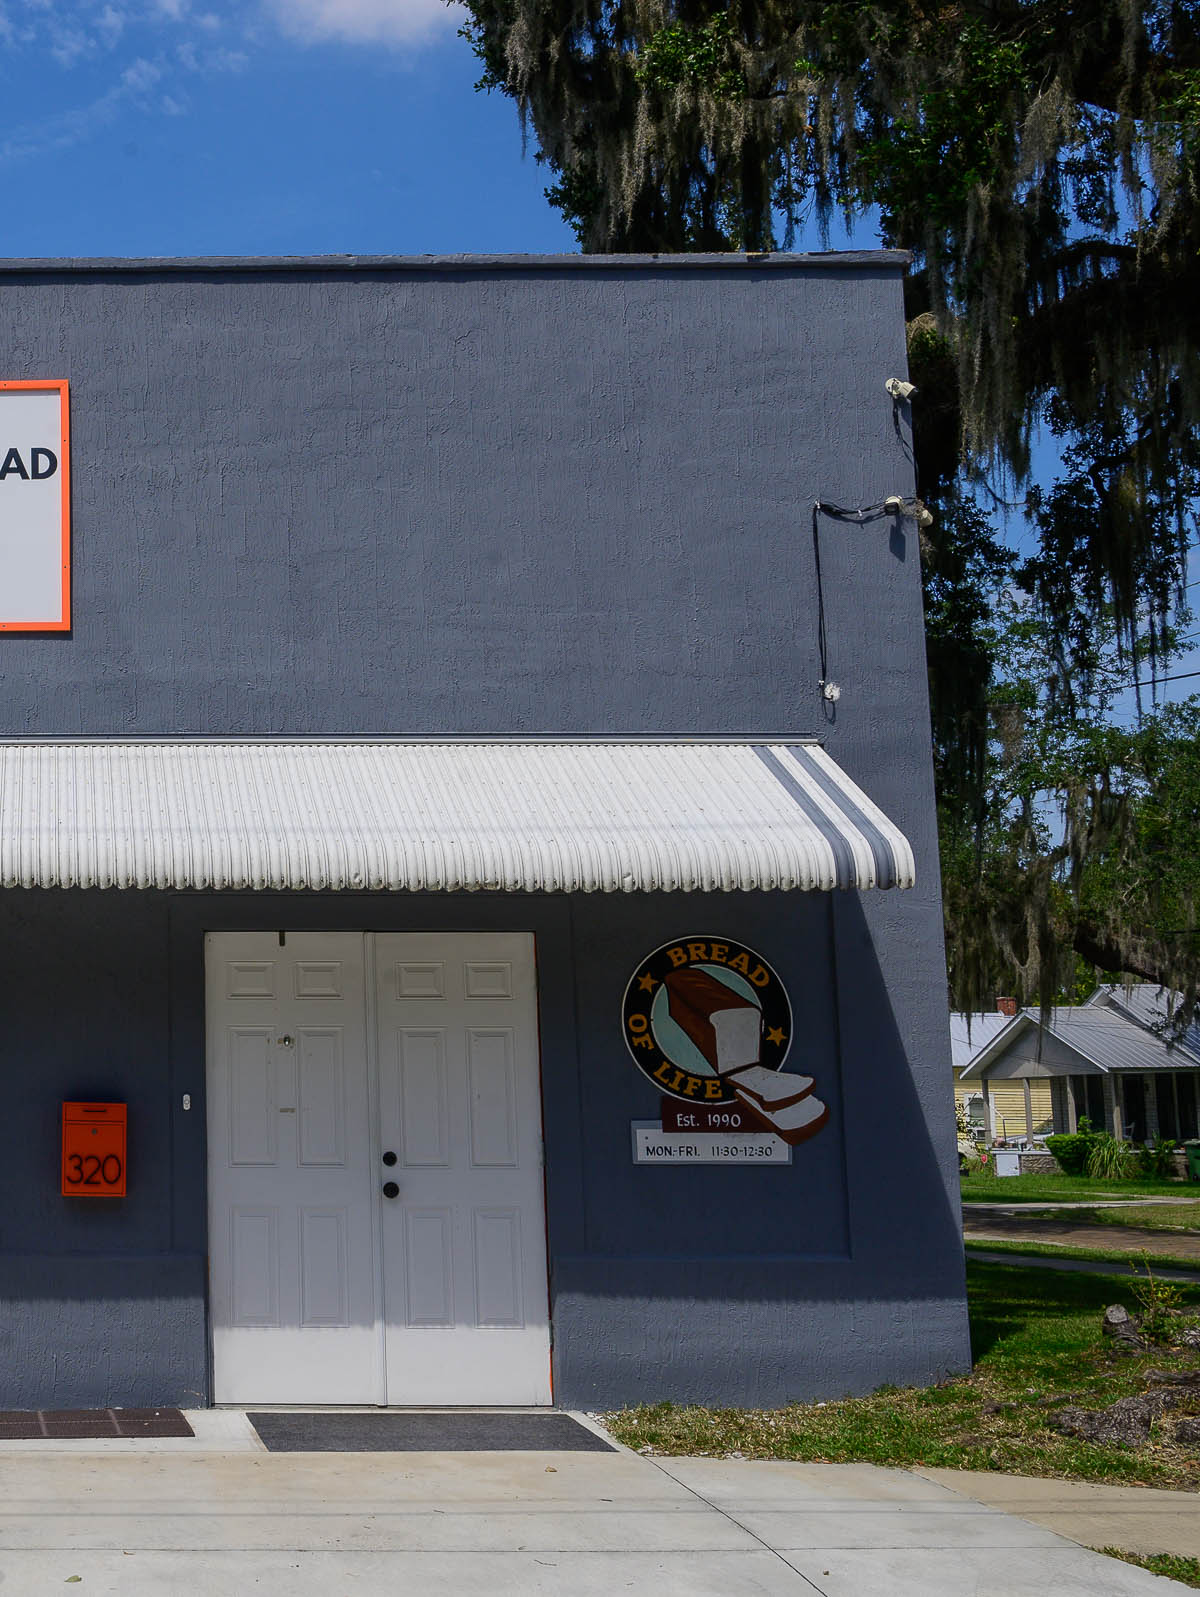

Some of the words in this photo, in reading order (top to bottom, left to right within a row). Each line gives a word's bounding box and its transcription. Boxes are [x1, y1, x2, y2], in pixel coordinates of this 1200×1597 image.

[666, 942, 771, 988] BREAD
[628, 1013, 655, 1051] OF
[653, 1061, 724, 1099] LIFE
[676, 1113, 700, 1127] Est.
[707, 1113, 742, 1127] 1990
[711, 1146, 773, 1157] 11:30-12:30
[66, 1154, 122, 1185] 320
